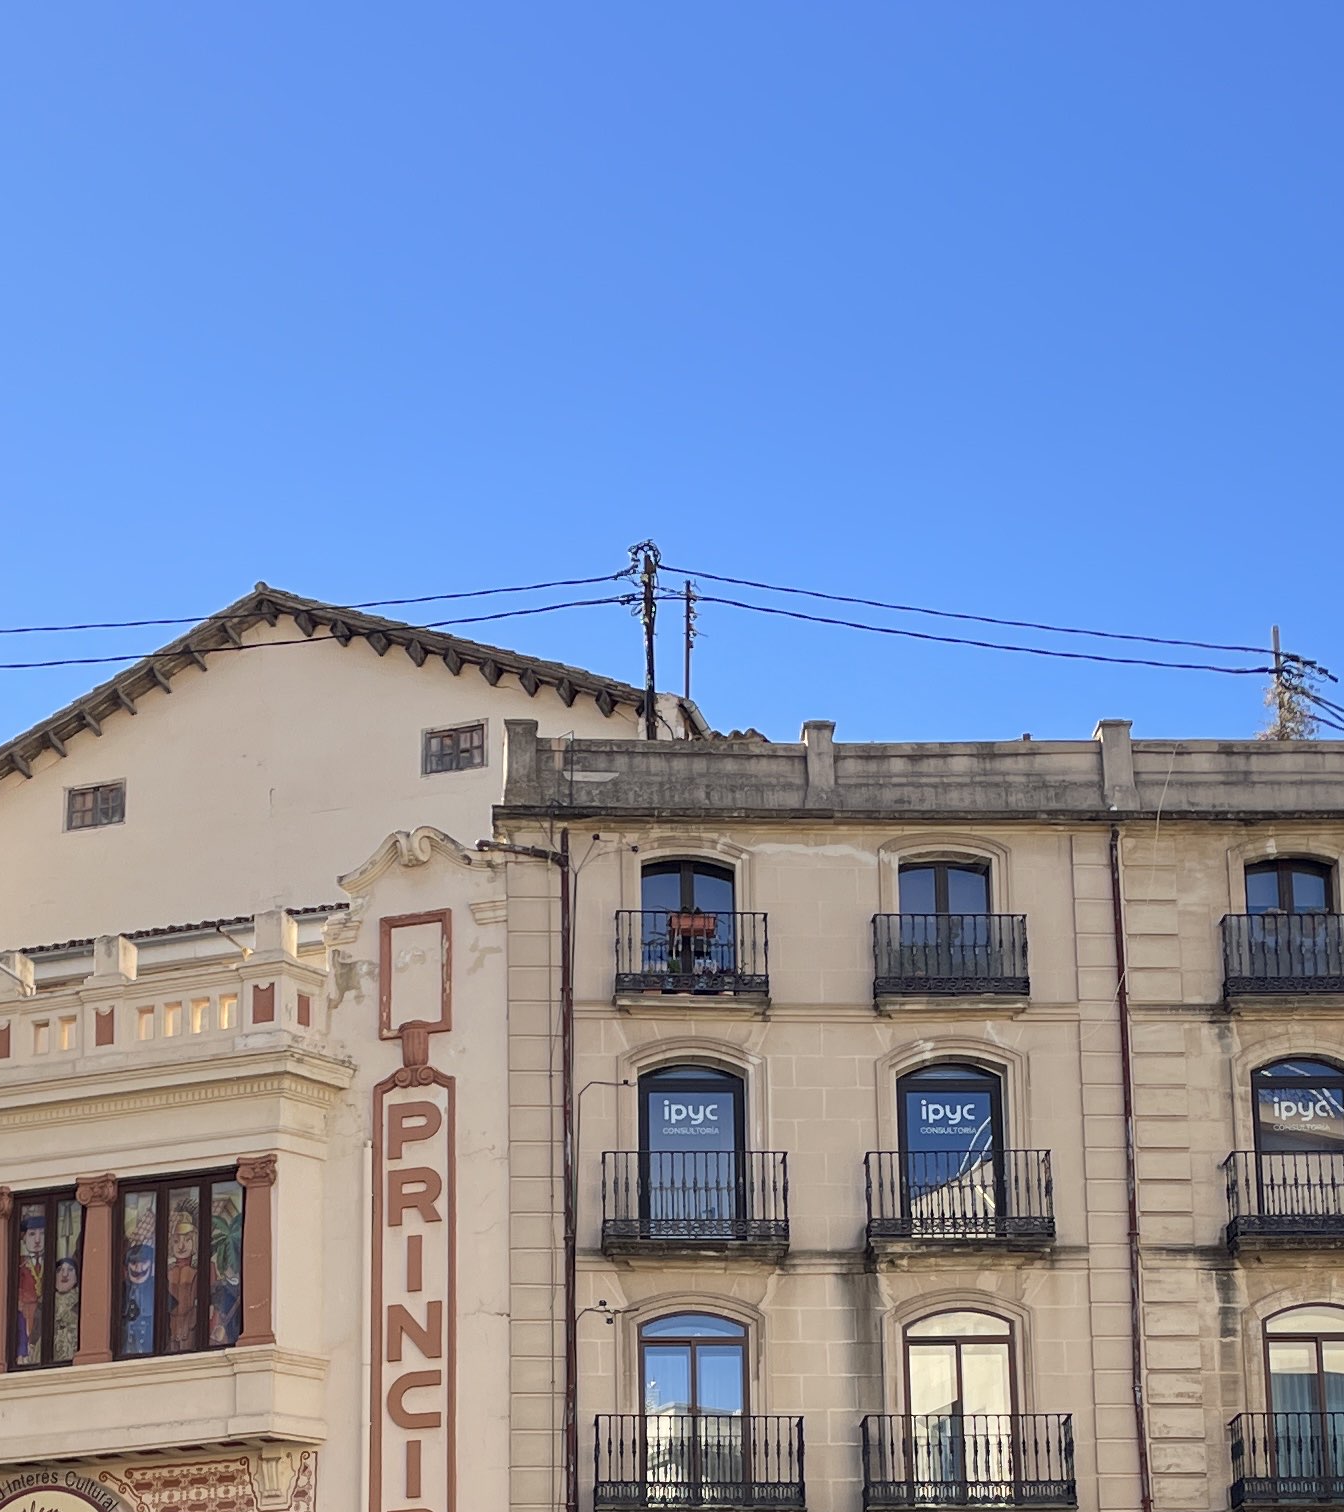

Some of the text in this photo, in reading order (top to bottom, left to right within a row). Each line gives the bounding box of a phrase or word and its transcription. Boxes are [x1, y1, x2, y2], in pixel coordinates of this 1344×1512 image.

[663, 1099, 718, 1125] ipyc
[921, 1099, 975, 1125] ipyc
[1273, 1096, 1328, 1121] ipyc
[65, 1470, 120, 1512] Cultural
